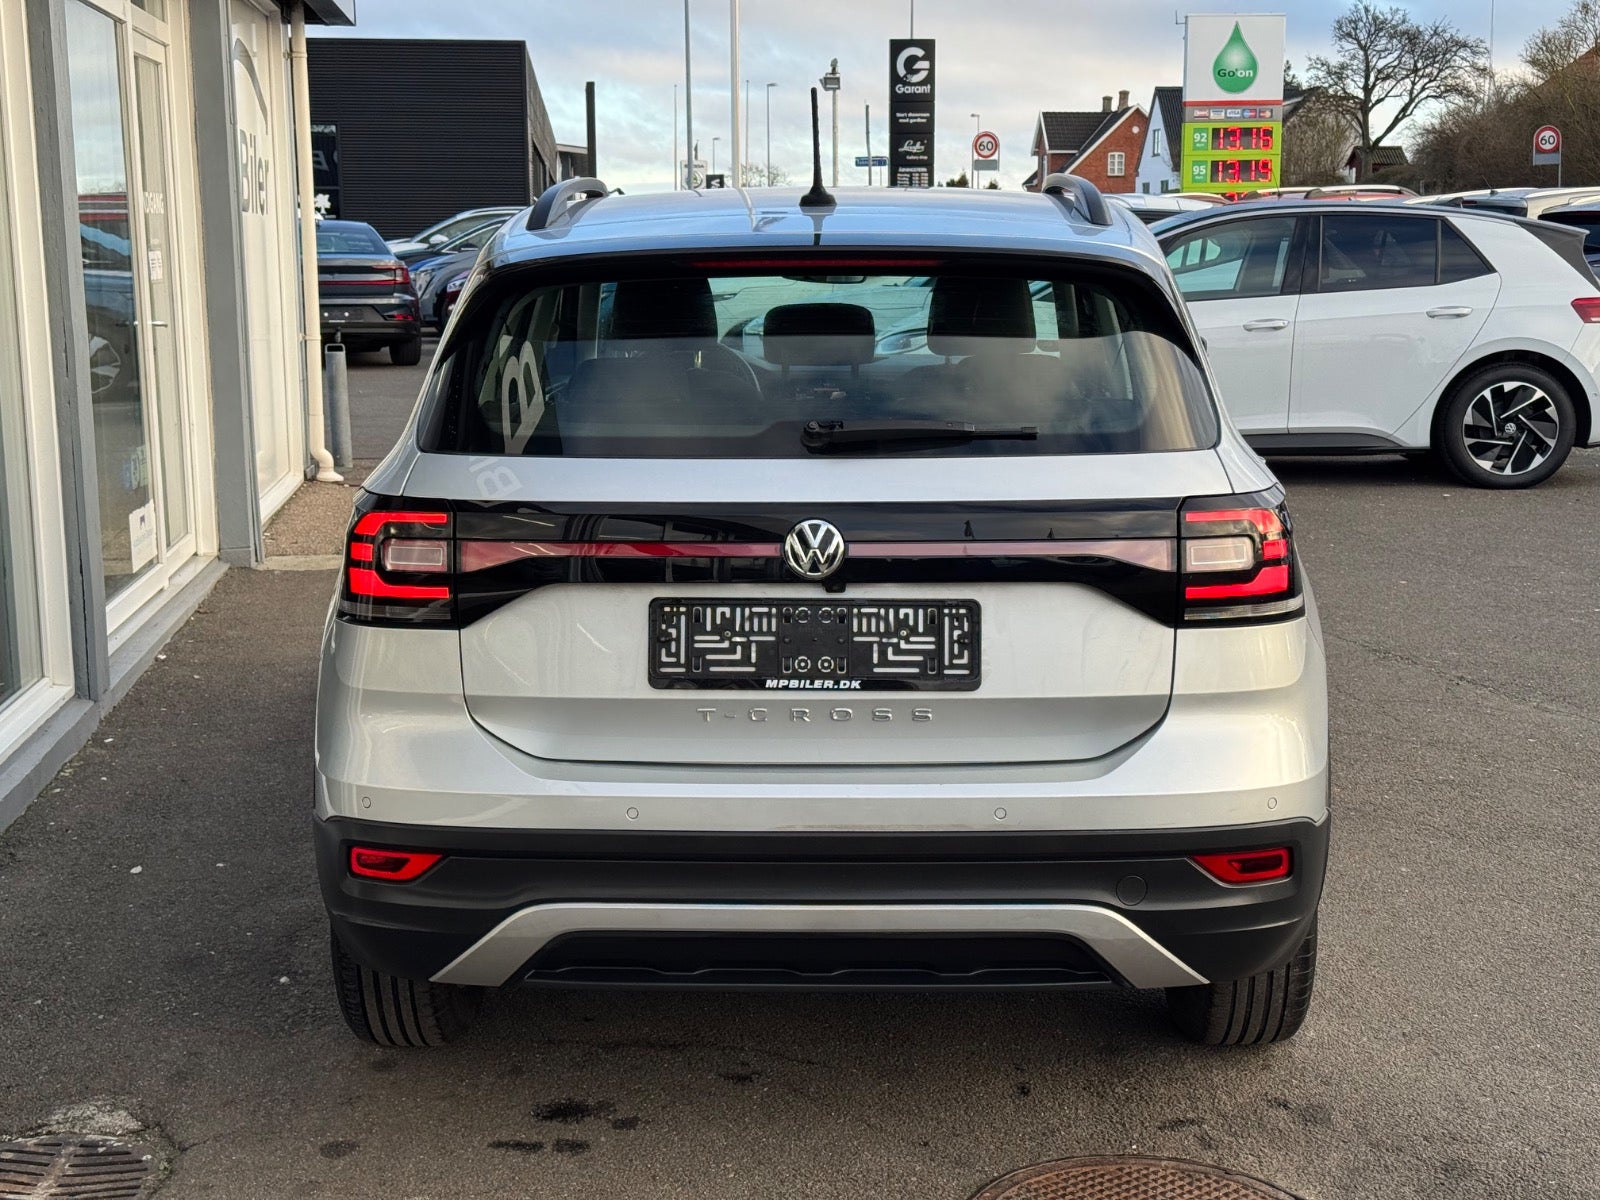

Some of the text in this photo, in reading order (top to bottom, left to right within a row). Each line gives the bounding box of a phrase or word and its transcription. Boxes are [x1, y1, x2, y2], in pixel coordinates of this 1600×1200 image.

[895, 84, 931, 94] Garant
[1193, 133, 1208, 143] 92
[1540, 135, 1556, 146] 60
[978, 140, 994, 151] 60
[239, 129, 269, 216] Biler
[1192, 165, 1206, 175] 95
[765, 679, 861, 689] MPBILER.DK
[697, 707, 933, 722] T-CROSS
